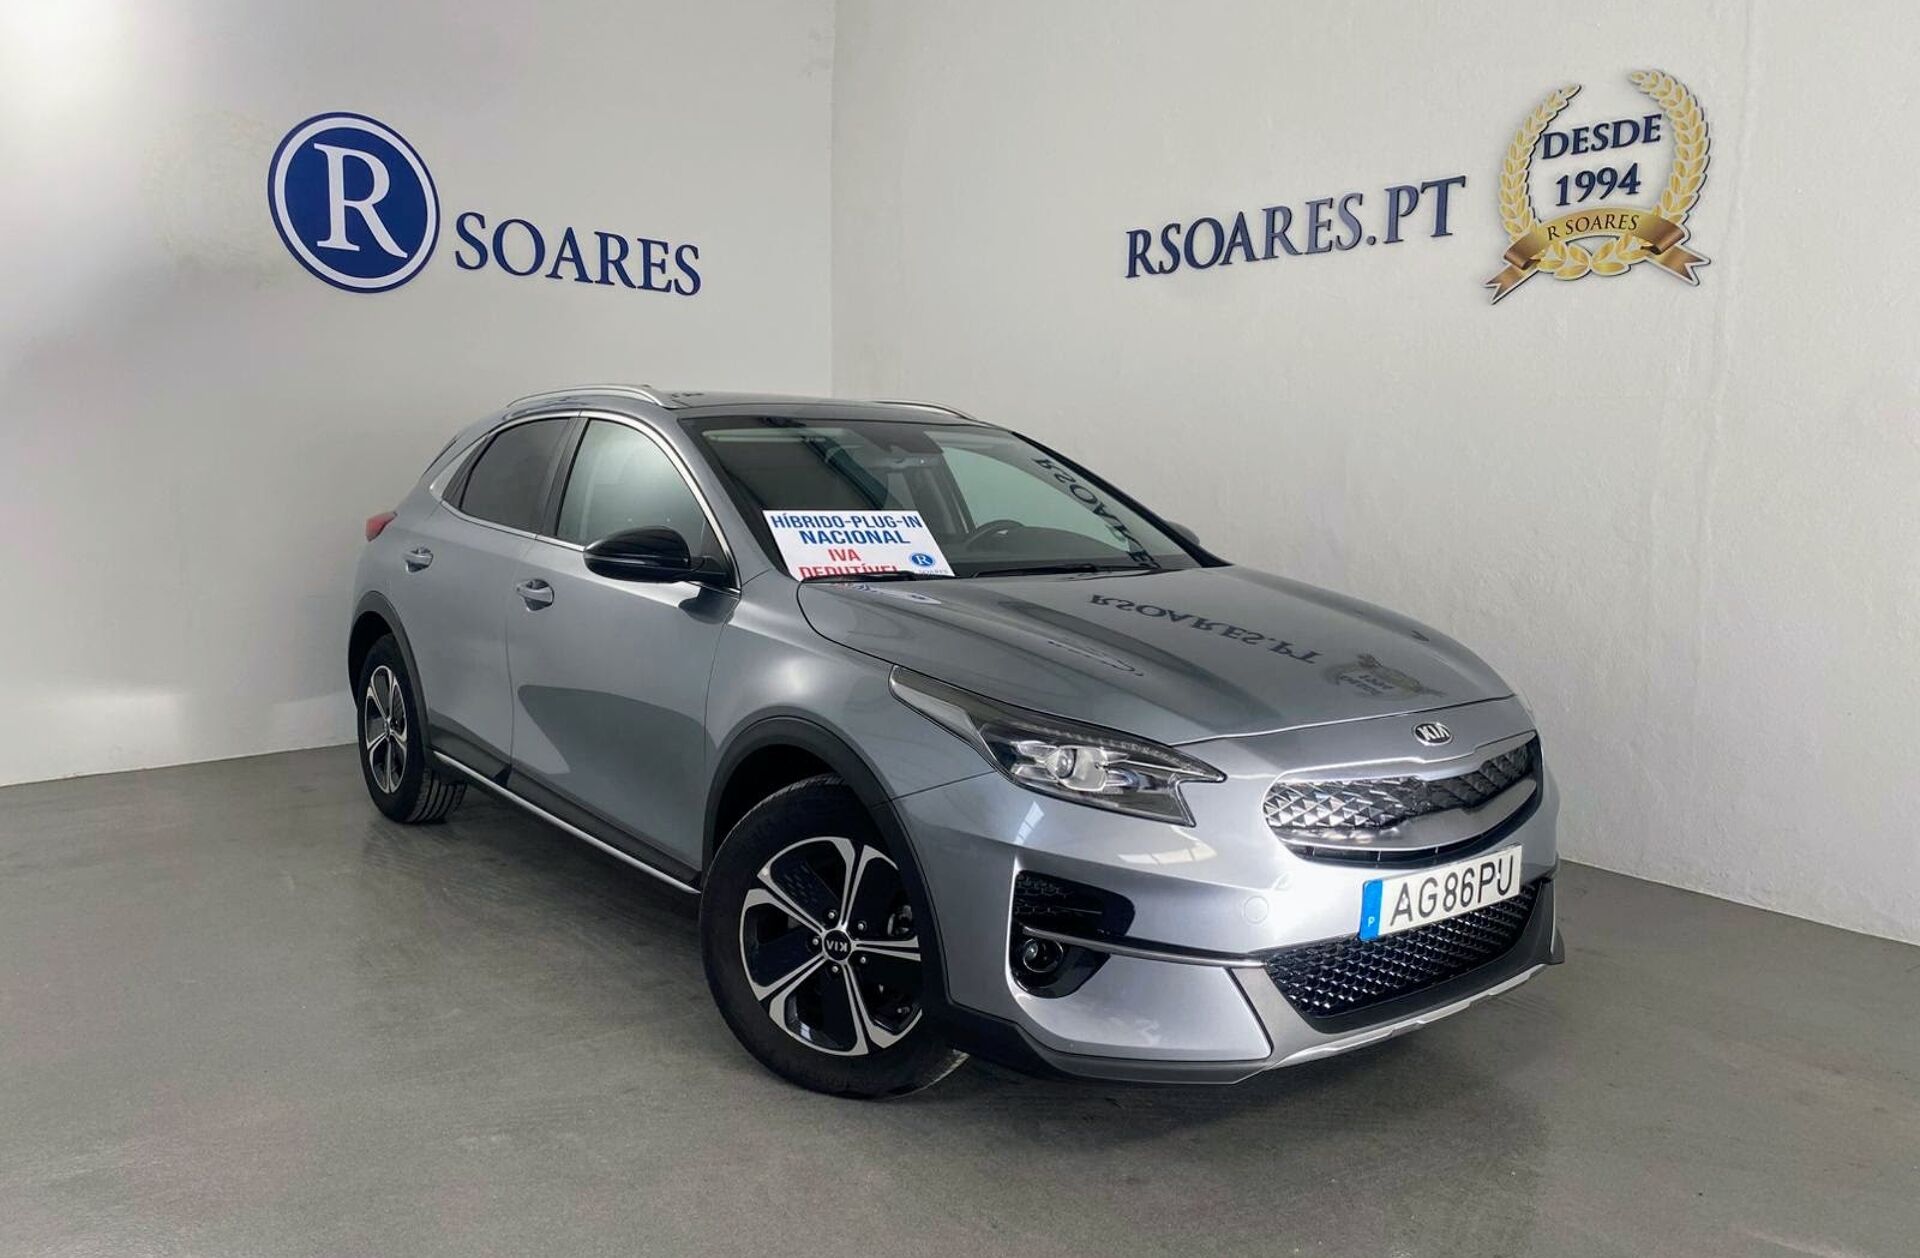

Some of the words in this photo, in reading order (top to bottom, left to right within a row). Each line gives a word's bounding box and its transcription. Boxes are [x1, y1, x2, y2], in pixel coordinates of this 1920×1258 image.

[1541, 113, 1663, 160] DESDE
[1555, 162, 1642, 207] 1994
[313, 142, 408, 259] R
[455, 211, 702, 297] SOARES
[1125, 175, 1467, 279] RSOARES.PT
[1547, 225, 1560, 241] R
[1565, 214, 1640, 235] SOARES
[770, 512, 924, 529] HÍBRIDO-PLUG-IN
[799, 530, 911, 545] NACIONAL
[827, 548, 861, 562] IVA
[915, 555, 931, 566] R
[1417, 722, 1450, 740] KIA
[1367, 916, 1376, 927] P
[1390, 854, 1514, 927] AG86PU
[826, 939, 848, 952] KIA
